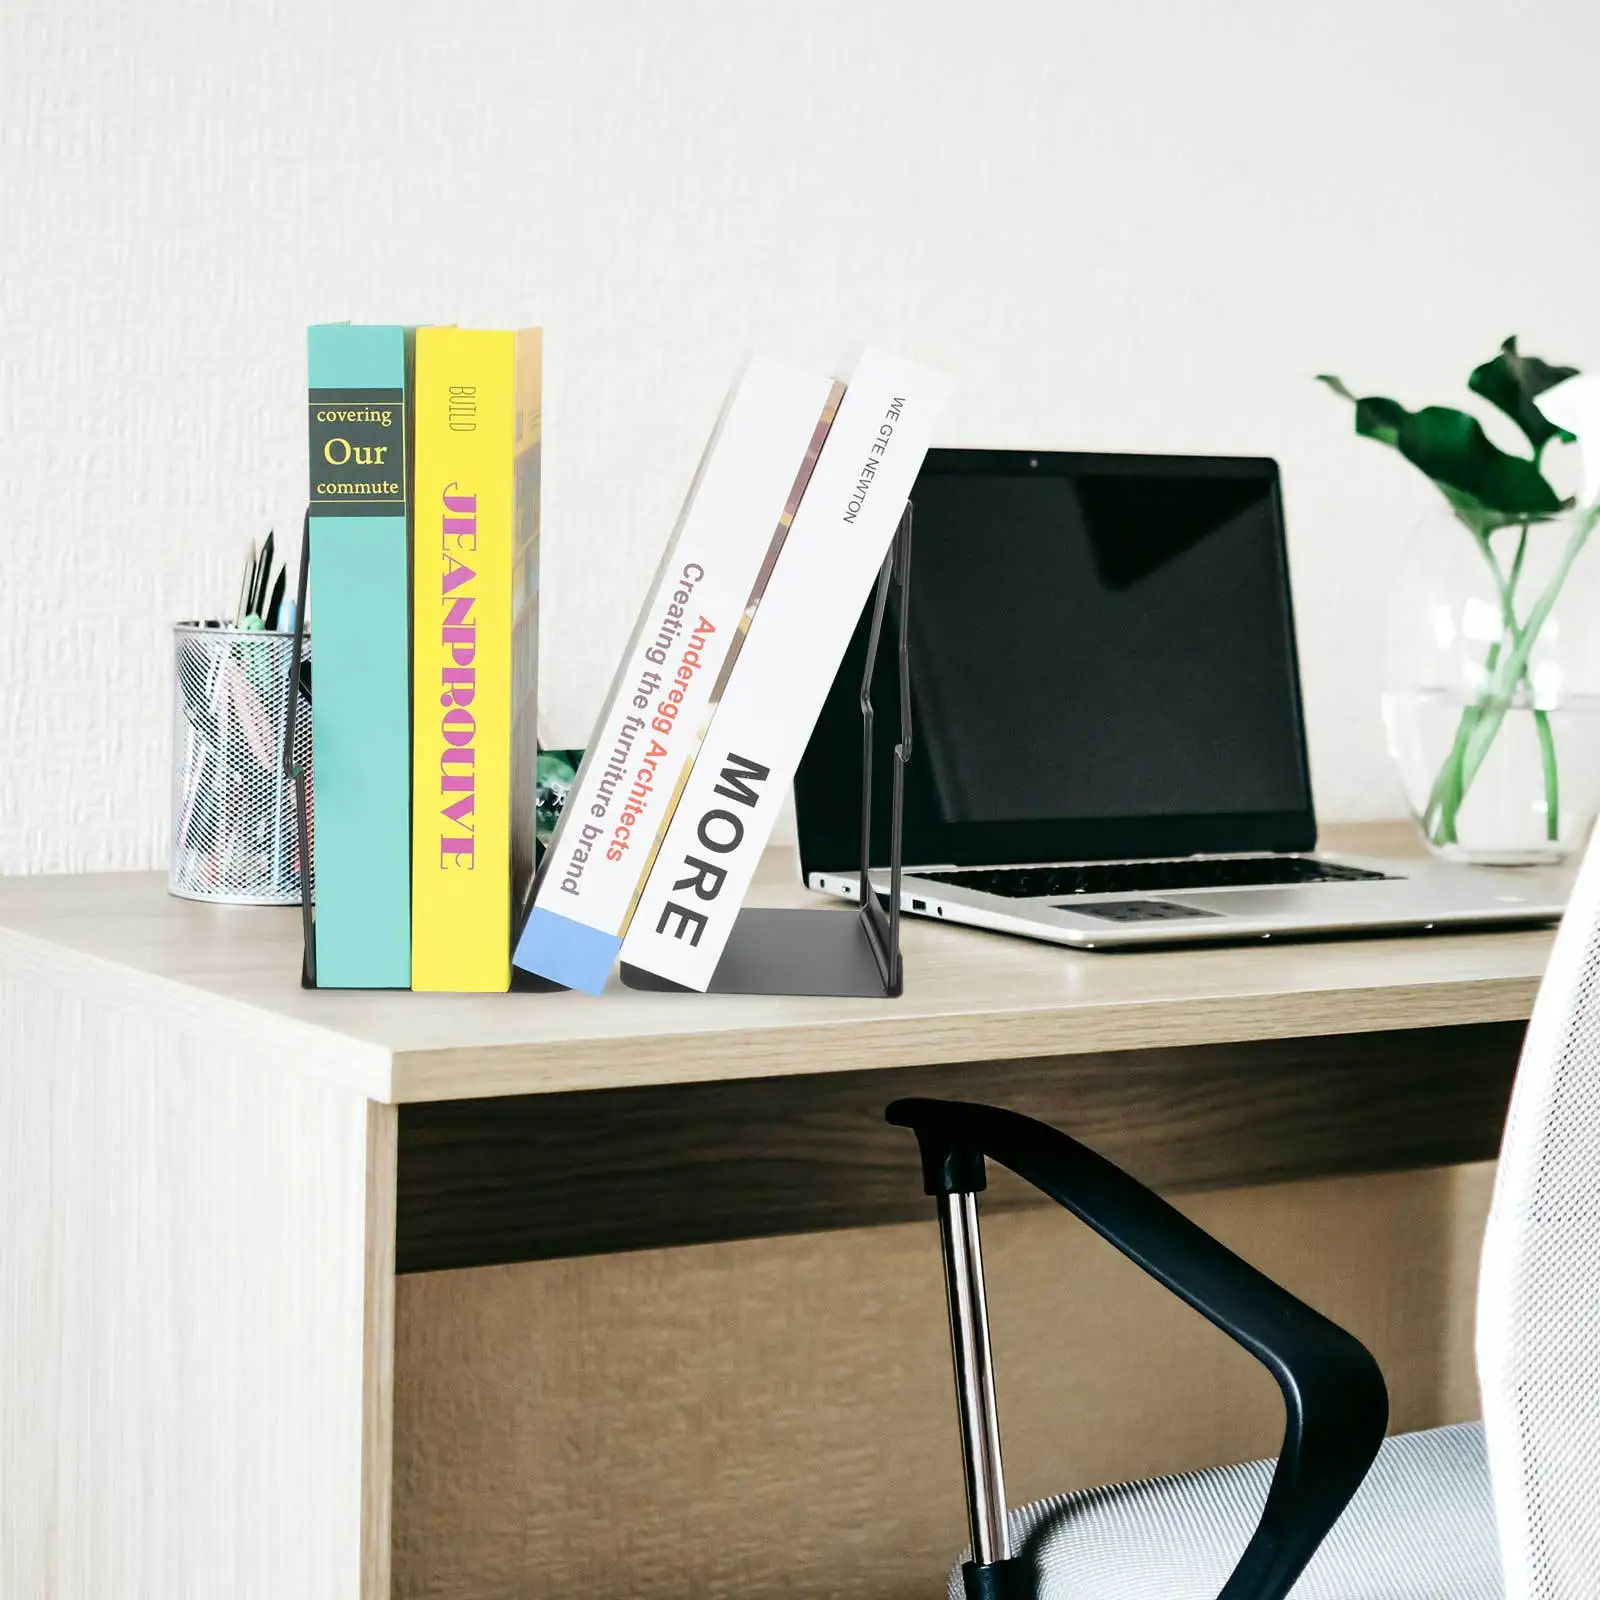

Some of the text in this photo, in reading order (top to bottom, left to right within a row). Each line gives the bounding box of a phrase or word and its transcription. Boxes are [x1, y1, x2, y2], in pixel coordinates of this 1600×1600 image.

[317, 407, 392, 427] covering
[324, 437, 388, 465] Our
[448, 385, 477, 432] BUILD
[317, 480, 399, 494] commute
[842, 397, 906, 524] WE GTE NEWTON
[560, 563, 705, 896] Creating the furniture brand
[606, 615, 716, 861] Anderegg Architects
[655, 752, 771, 948] MORE
